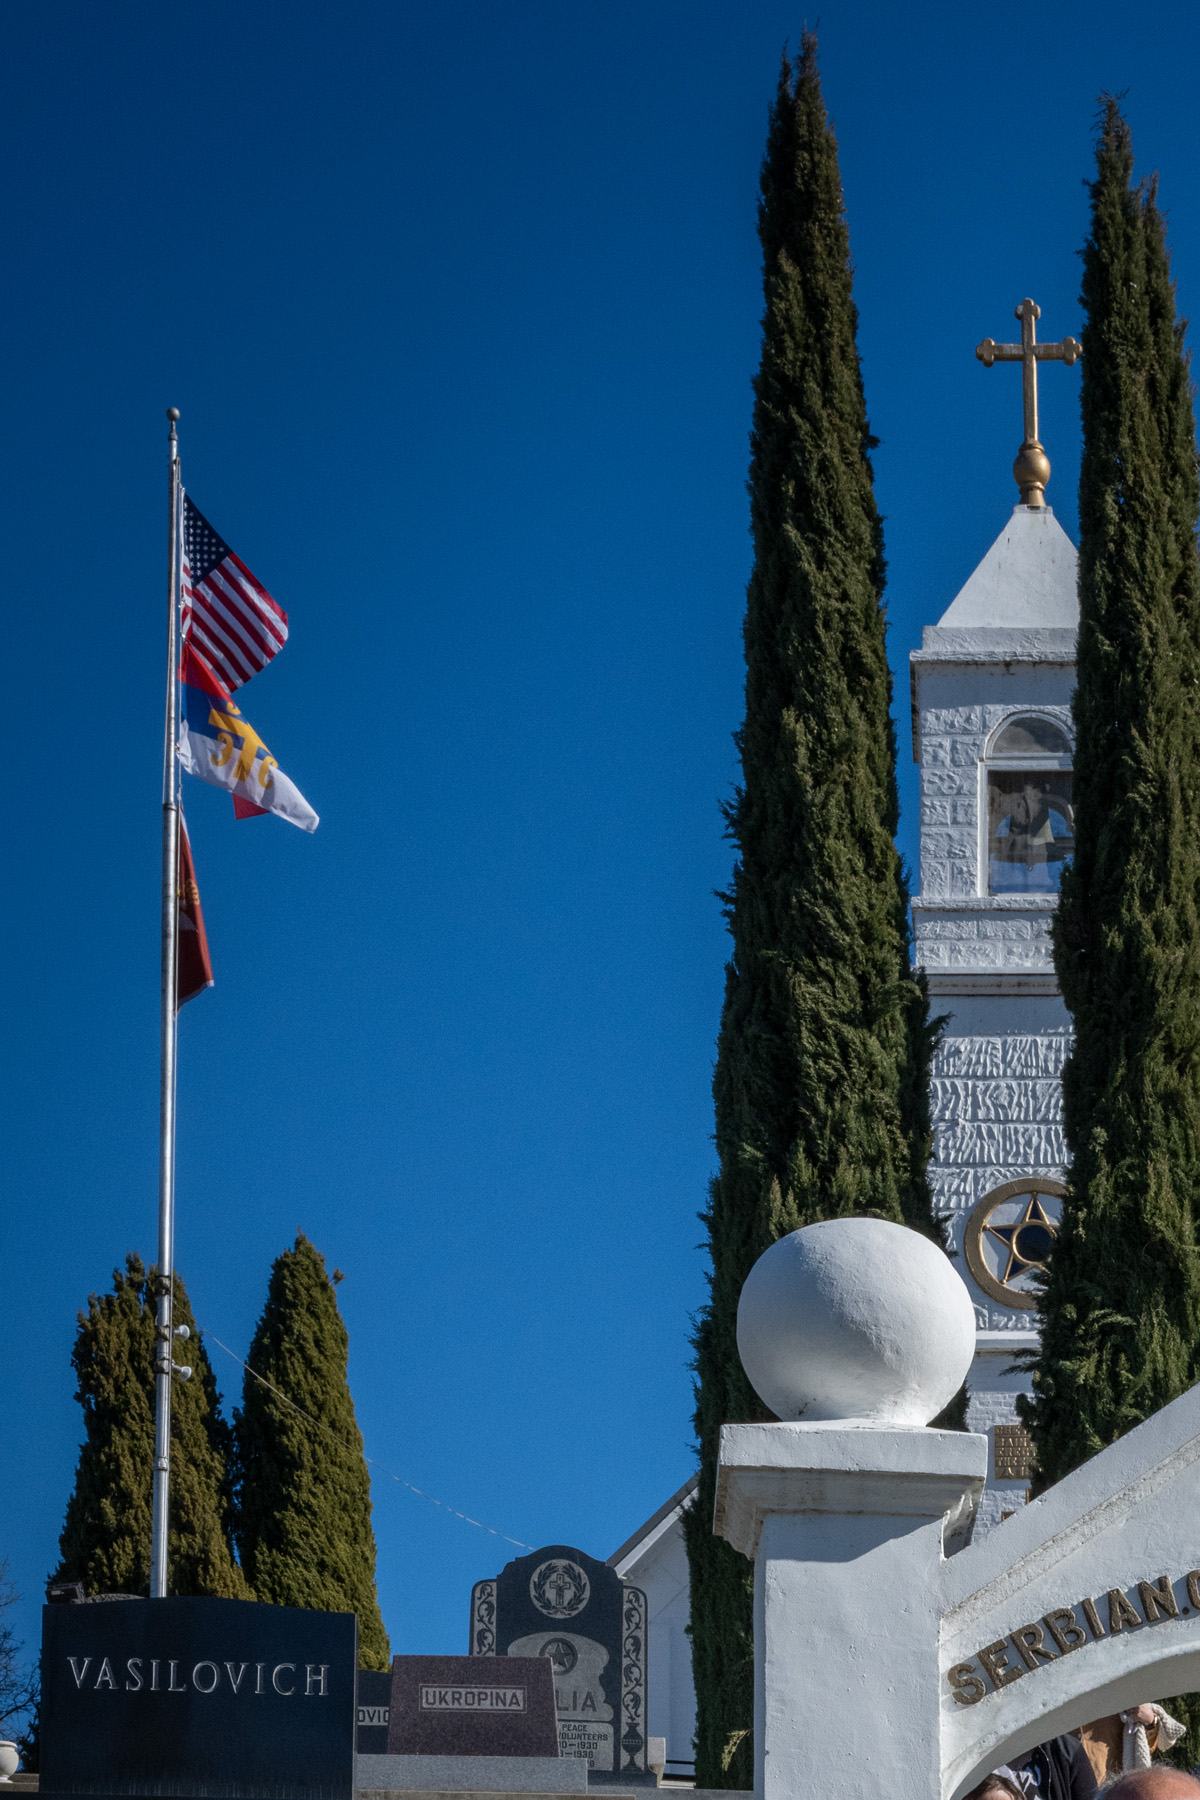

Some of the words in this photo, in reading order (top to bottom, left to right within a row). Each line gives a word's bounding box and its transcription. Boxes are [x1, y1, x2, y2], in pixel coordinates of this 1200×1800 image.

[66, 1656, 330, 1696] VASILOVICH
[423, 1689, 522, 1708] UKROPINA
[562, 1723, 588, 1732] PEACE
[559, 1732, 609, 1741] OLUNTEERS
